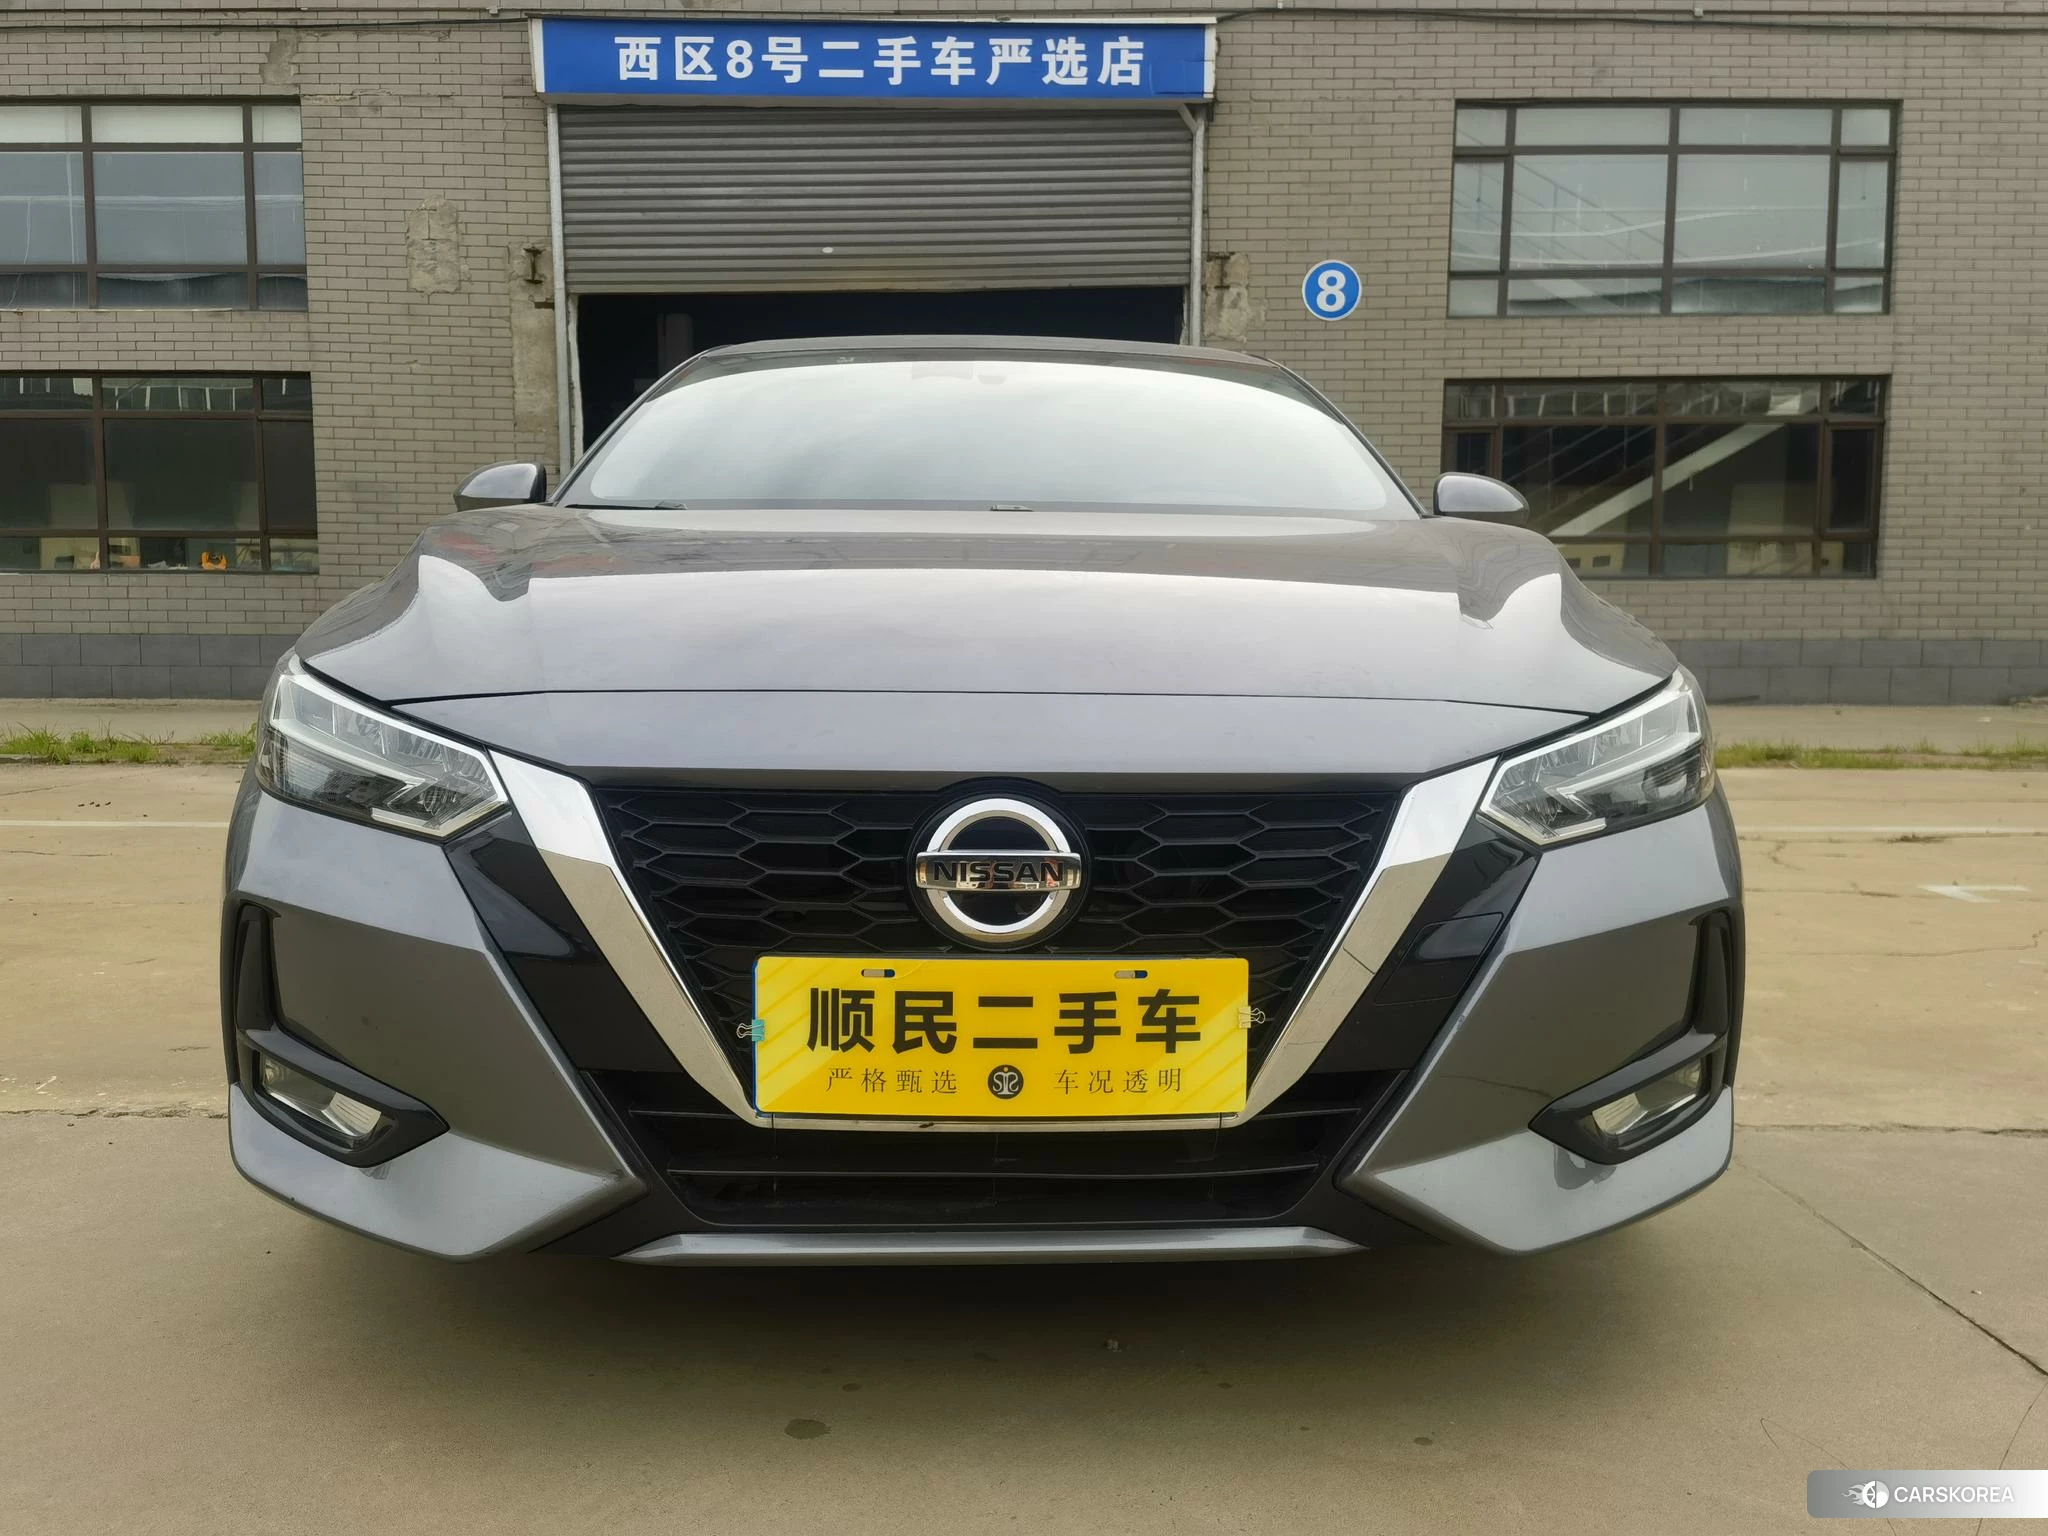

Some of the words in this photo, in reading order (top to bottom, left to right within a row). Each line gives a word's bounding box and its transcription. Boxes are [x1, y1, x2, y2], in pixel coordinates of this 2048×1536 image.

[614, 36, 1144, 87] 西区8号二手车严选店
[1316, 269, 1346, 312] 8
[933, 861, 1064, 883] NISSAN
[806, 987, 1201, 1055] 顺民二手车
[826, 1067, 957, 1095] 严格甄选
[1053, 1067, 1182, 1095] 车况透明
